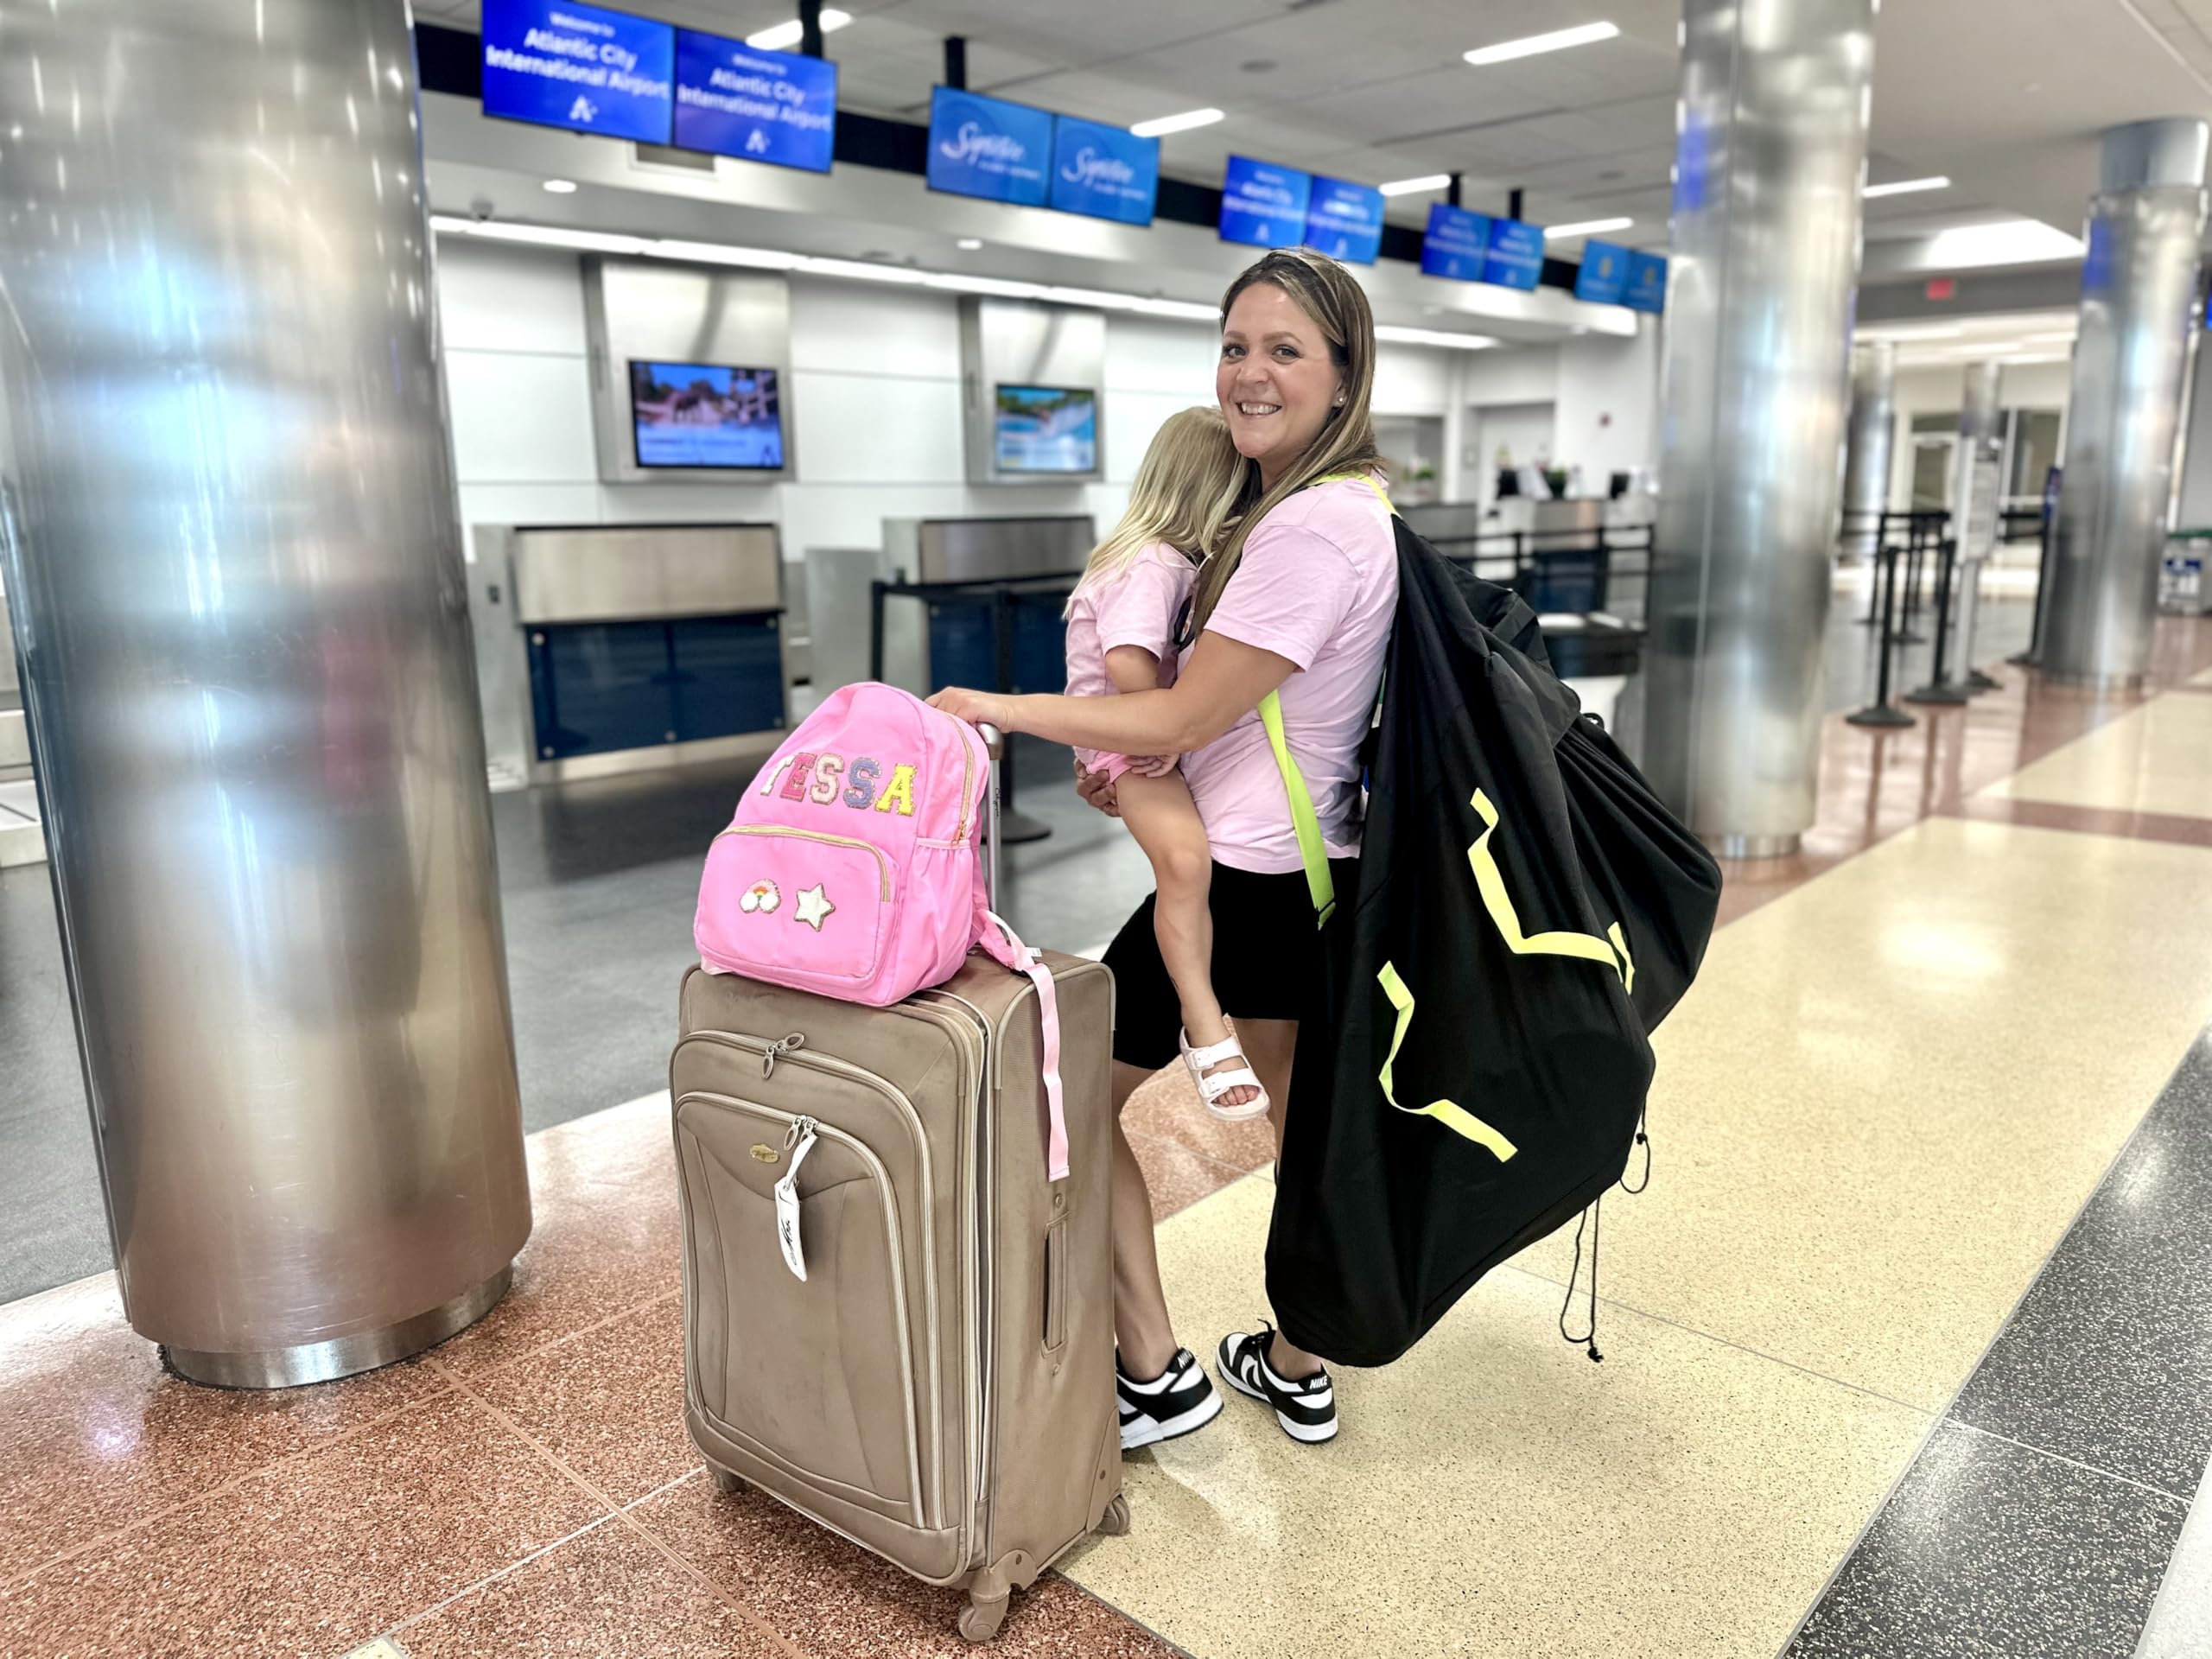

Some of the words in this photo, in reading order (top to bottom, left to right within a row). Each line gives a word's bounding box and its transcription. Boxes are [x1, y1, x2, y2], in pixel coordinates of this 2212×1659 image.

[524, 28, 598, 60] Atlantic
[600, 43, 638, 71] City
[486, 44, 607, 86] International
[608, 71, 670, 99] Airport
[709, 67, 772, 97] Atlantic
[772, 80, 805, 107] City
[677, 84, 779, 120] International
[780, 105, 832, 131] Airport
[1309, 1376, 1328, 1389] NIKE
